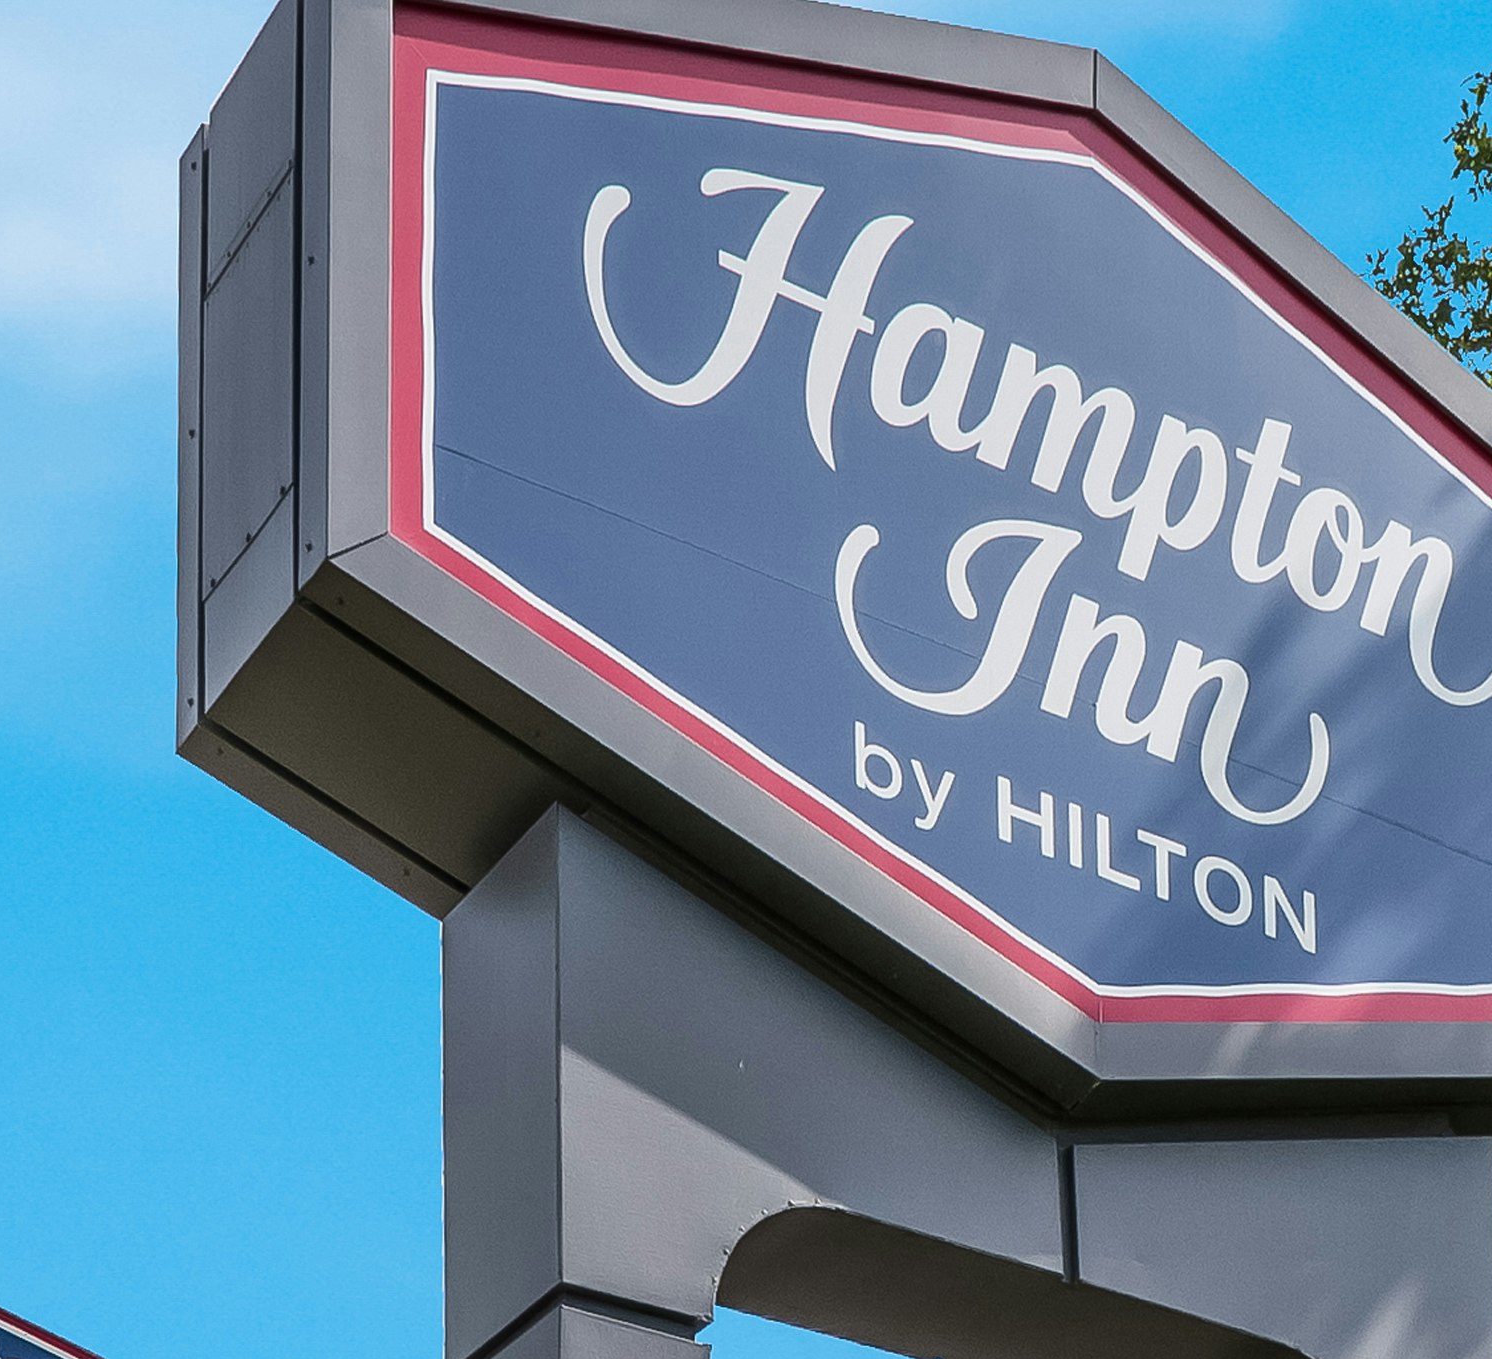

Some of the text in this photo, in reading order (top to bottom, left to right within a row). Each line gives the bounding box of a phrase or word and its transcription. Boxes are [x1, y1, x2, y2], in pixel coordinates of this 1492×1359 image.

[835, 520, 1330, 825] Inn
[855, 722, 1318, 954] by HILTON
